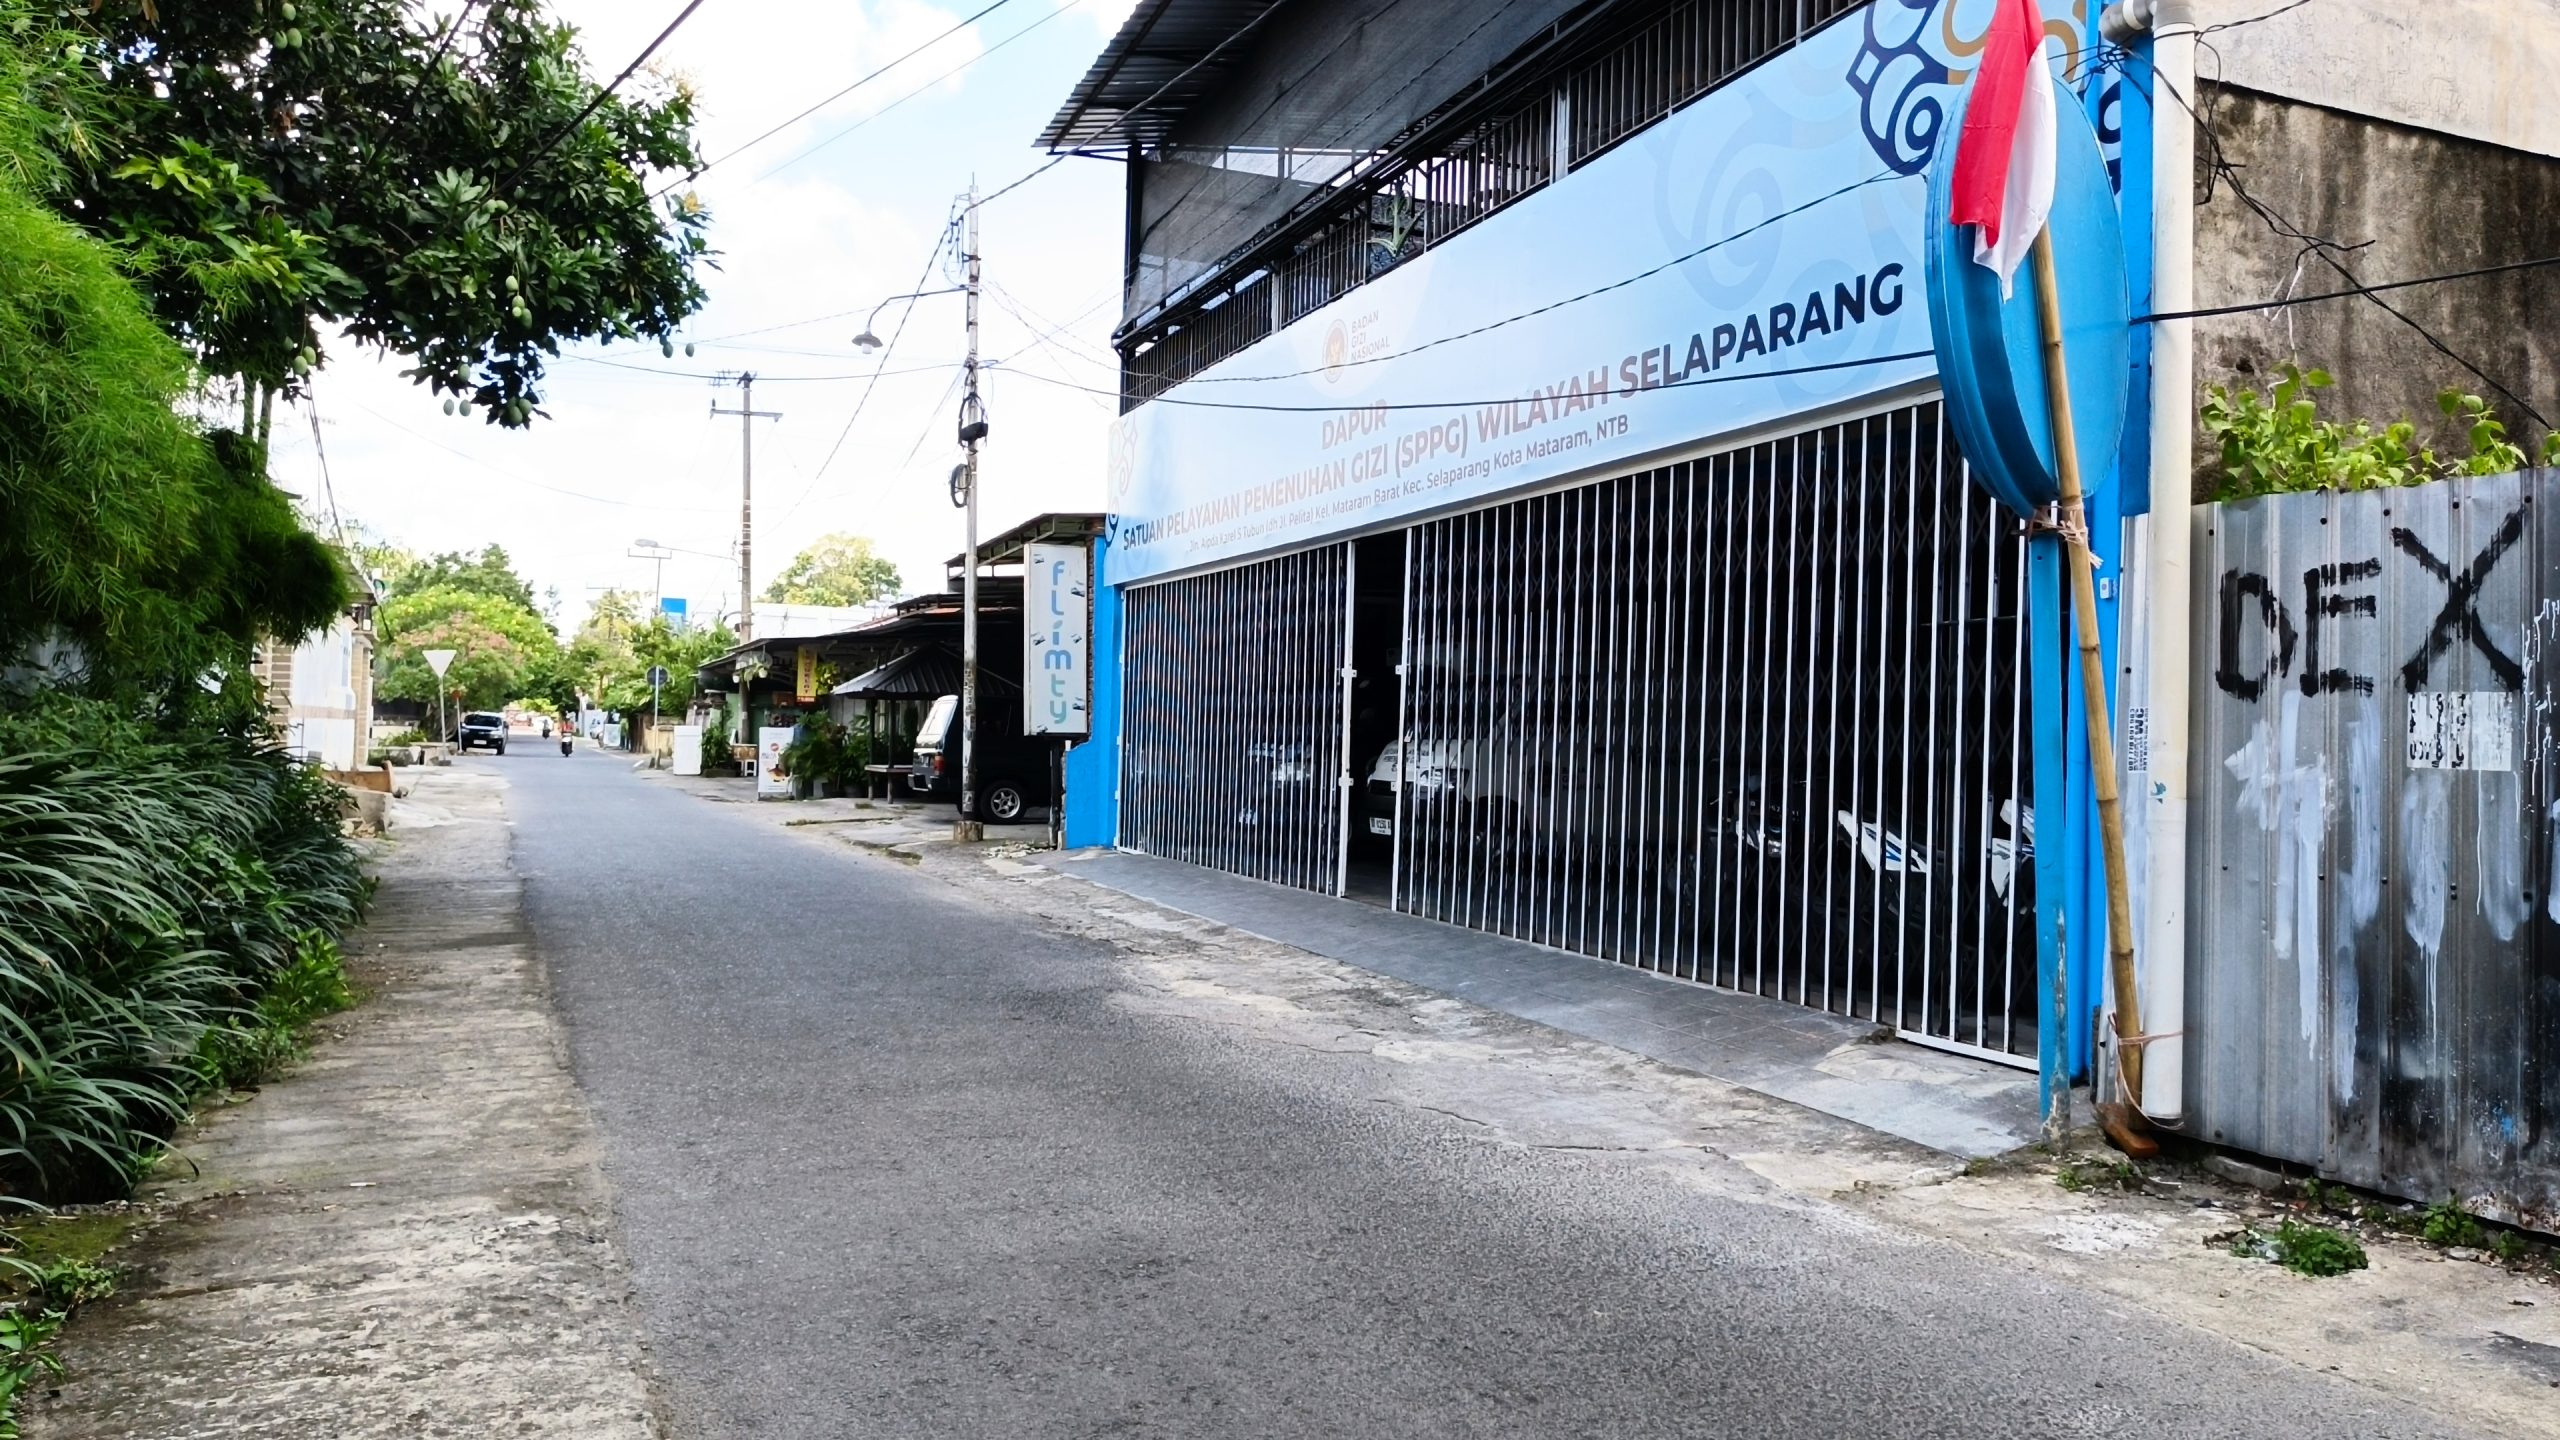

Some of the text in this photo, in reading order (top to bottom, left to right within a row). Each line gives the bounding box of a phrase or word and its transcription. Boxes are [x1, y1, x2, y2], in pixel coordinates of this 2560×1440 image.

[1351, 335, 1391, 361] NASIONAL
[1352, 311, 1378, 333] BADAN
[1352, 332, 1366, 348] GIZI
[1122, 262, 1904, 551] SATUAN PELAYANAN PEMENUHAN GIZI (SPPG) WILAYAH SELAPARANG
[1321, 398, 1388, 450] DAPUR
[1331, 494, 1372, 515] Mataram
[1373, 486, 1401, 506] Barat
[1402, 477, 1425, 496] Kec.
[1426, 462, 1490, 489] Selaparang
[1493, 442, 1523, 468] Kota
[1526, 427, 1593, 459] Mataram,
[1596, 414, 1629, 441] NTB
[2216, 505, 2526, 702] DEX
